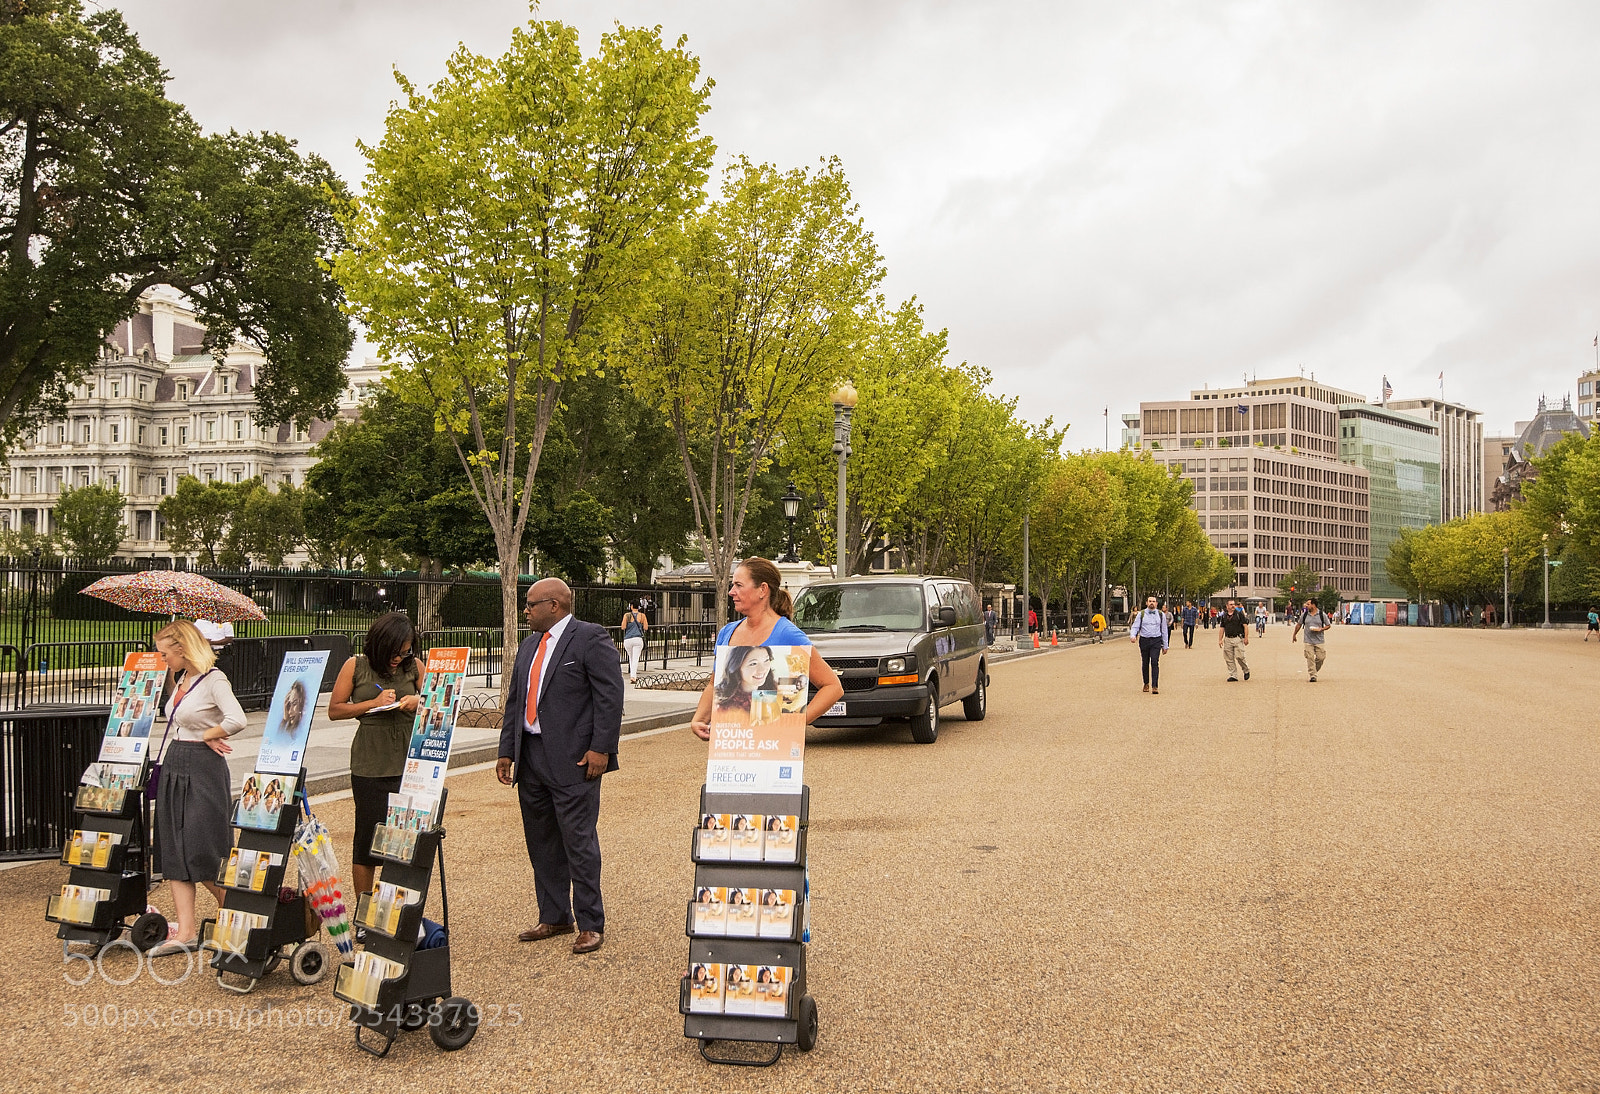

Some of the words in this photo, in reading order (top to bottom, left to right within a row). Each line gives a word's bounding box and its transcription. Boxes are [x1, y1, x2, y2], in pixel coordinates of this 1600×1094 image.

[285, 657, 297, 665] WILL
[297, 656, 324, 665] SUFFERING
[283, 665, 296, 673] EVER
[296, 665, 309, 673] END?
[430, 729, 439, 738] WHO
[438, 730, 447, 739] ARE
[715, 728, 754, 739] YOUNG
[423, 738, 447, 749] JEHOVAH'S
[714, 740, 755, 750] PEOPLE
[757, 740, 780, 751] ASK
[420, 748, 448, 759] WITNESSES?
[711, 772, 733, 783] FREE
[734, 773, 757, 783] COPY
